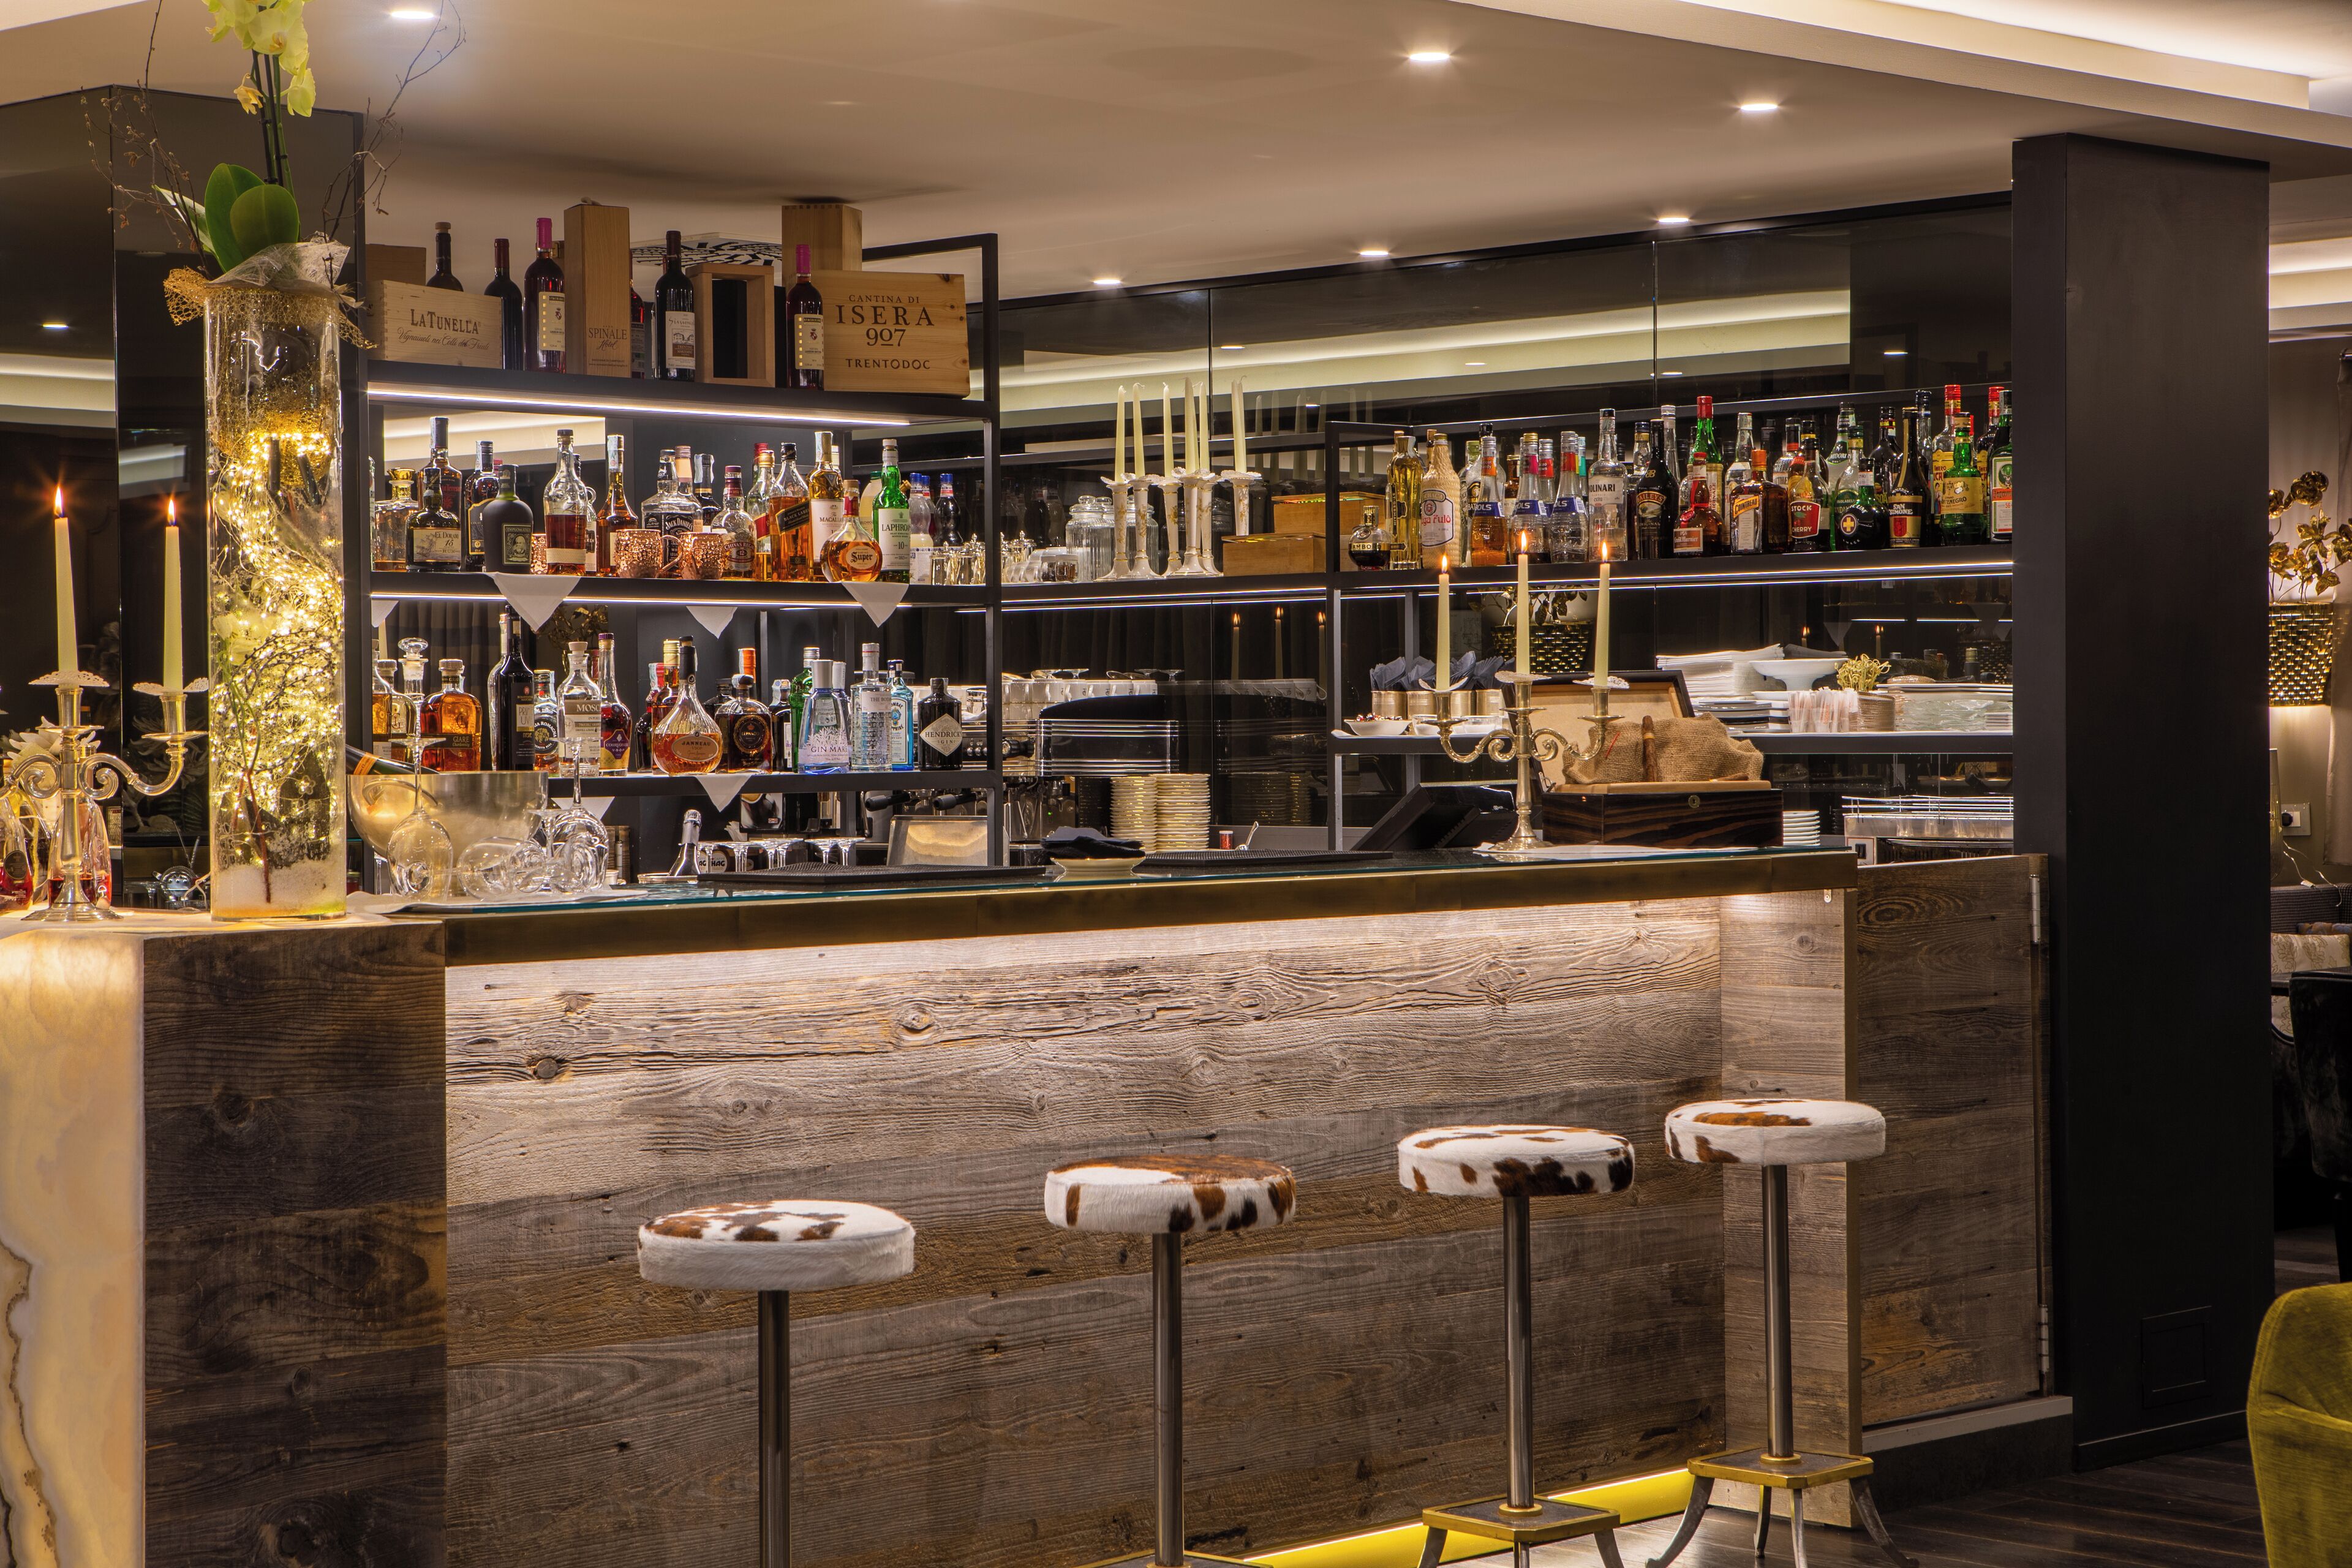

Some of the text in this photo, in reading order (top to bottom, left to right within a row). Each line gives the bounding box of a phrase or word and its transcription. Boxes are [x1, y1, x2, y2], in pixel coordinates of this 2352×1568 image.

[849, 295, 902, 303] CANTINA
[835, 305, 935, 326] ISERA
[588, 328, 627, 340] SPINALE
[865, 328, 907, 347] 907
[442, 333, 457, 346] Colli
[467, 337, 489, 350] Friuli
[596, 339, 619, 351] Hotel
[845, 358, 931, 370] TRENTODOC
[1637, 492, 1664, 502] BAILEYS
[1735, 498, 1757, 514] COINTREAU
[665, 520, 677, 530] JACK
[850, 552, 873, 562] Super
[540, 721, 557, 738] ROMAGNA
